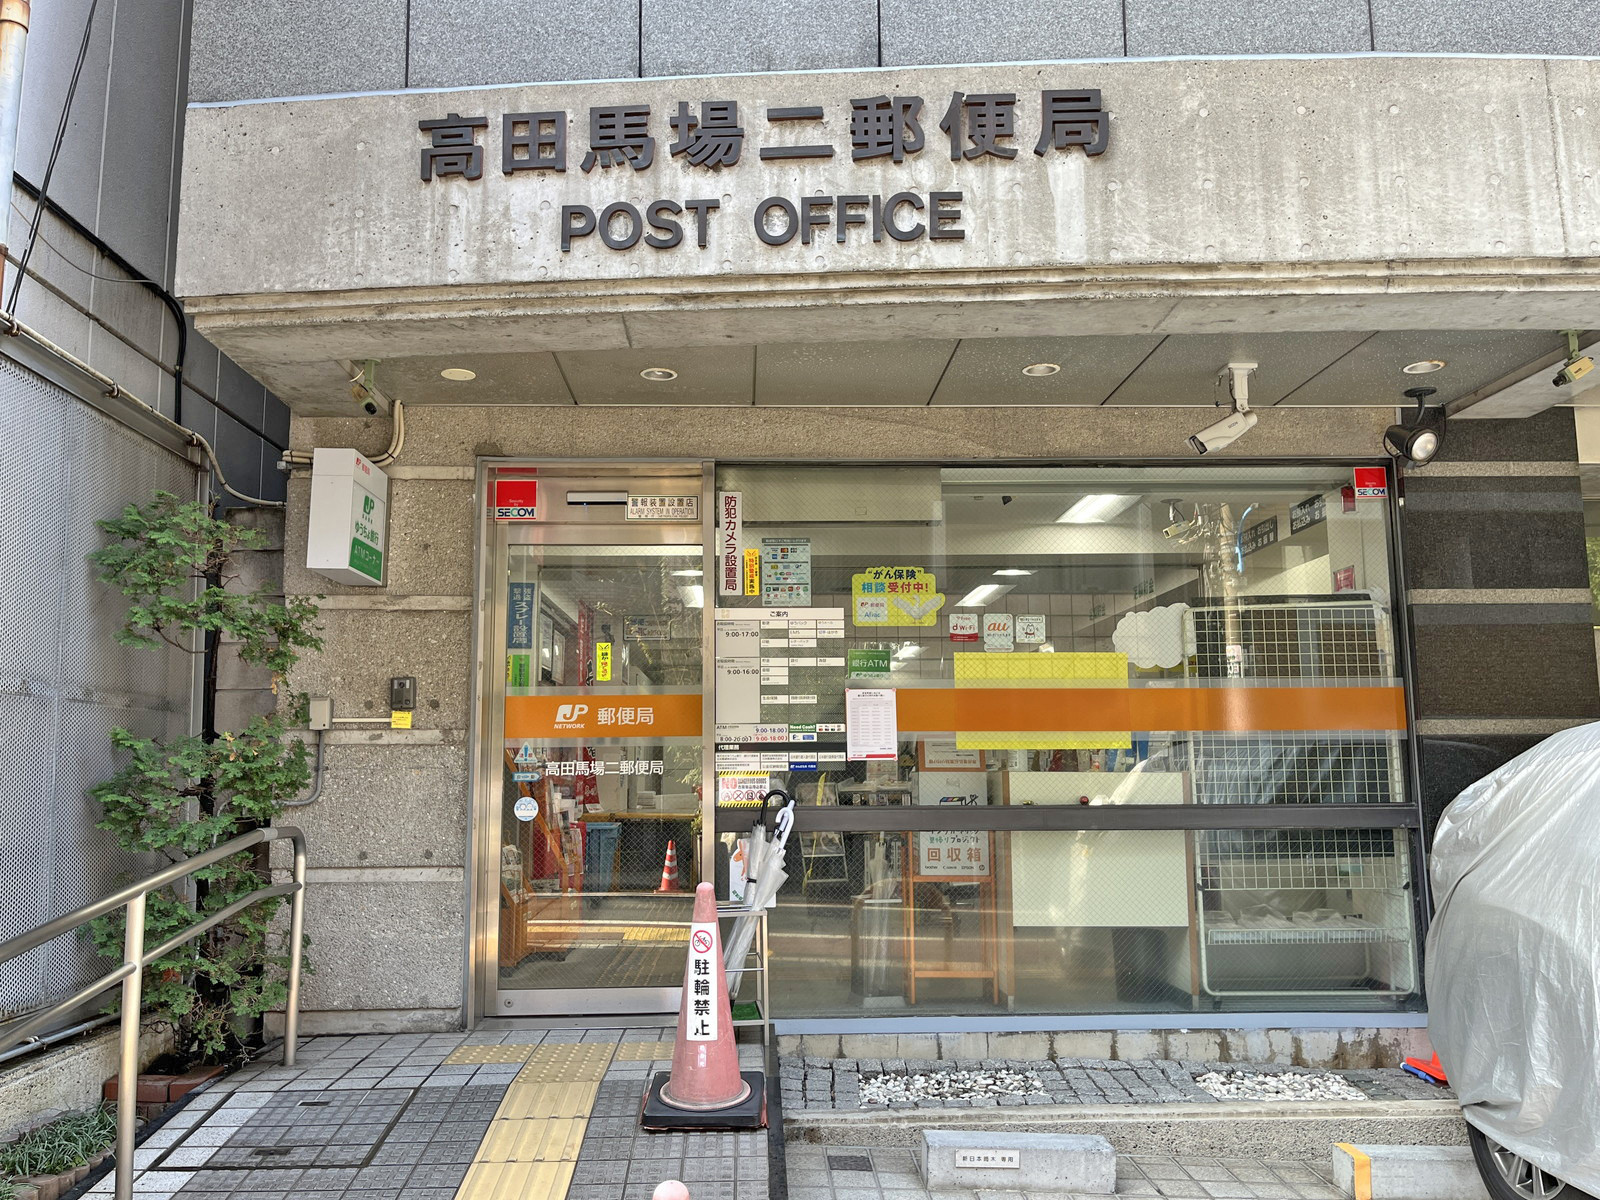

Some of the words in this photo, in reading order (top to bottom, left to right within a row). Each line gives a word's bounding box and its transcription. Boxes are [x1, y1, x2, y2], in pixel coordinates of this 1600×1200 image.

[419, 88, 1110, 182] 高田馬場二郵便局
[561, 198, 720, 252] POST
[753, 190, 965, 247] OFFICE
[1357, 488, 1386, 496] SECOM
[497, 508, 534, 517] SECOM
[724, 495, 738, 591] 防犯カメラ設置局
[987, 622, 1010, 632] au
[852, 659, 888, 668] 銀行ATM
[597, 707, 654, 726] 郵便局
[545, 760, 664, 776] 高田馬場二郵便局
[928, 848, 982, 862] 回収箱
[694, 959, 710, 1036] 駐輪禁止
